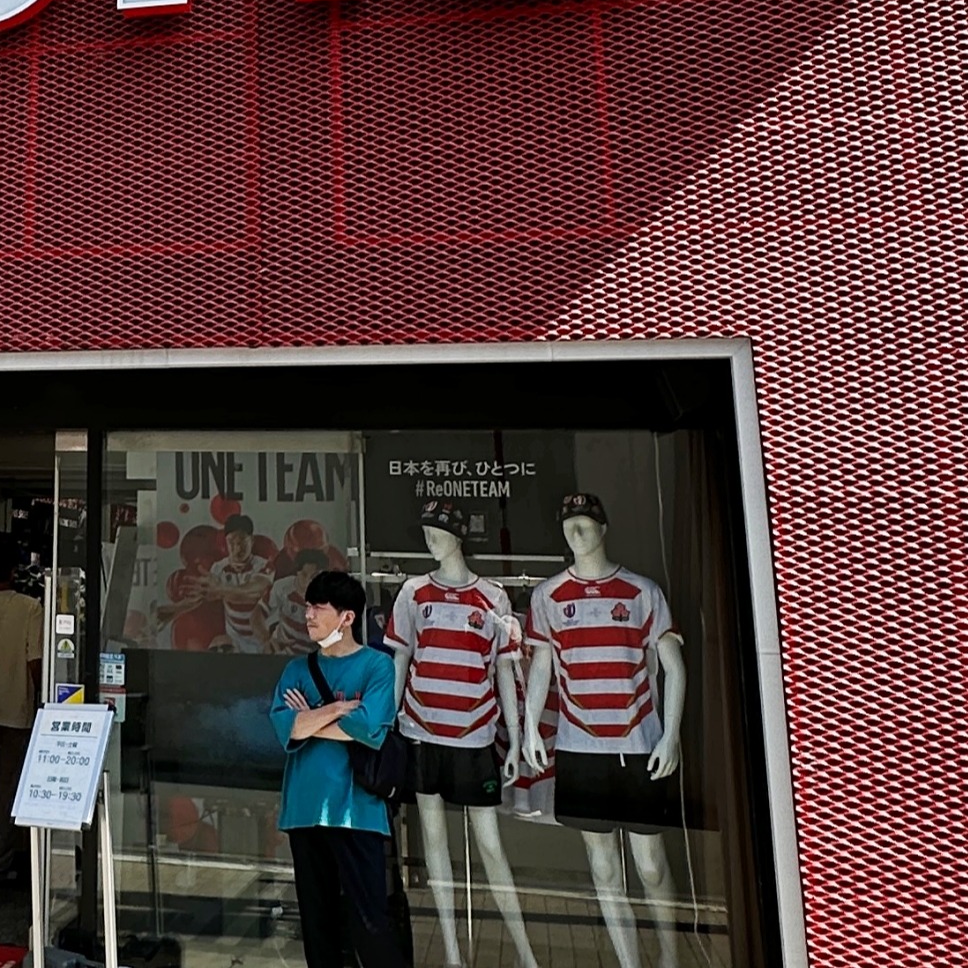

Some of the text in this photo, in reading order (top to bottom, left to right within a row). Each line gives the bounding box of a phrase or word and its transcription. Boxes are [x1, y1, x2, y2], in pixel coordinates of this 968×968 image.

[389, 460, 537, 477] 日本を再び、ひとつに
[415, 480, 511, 498] #ReONETEAM
[50, 721, 93, 733] 営業時間
